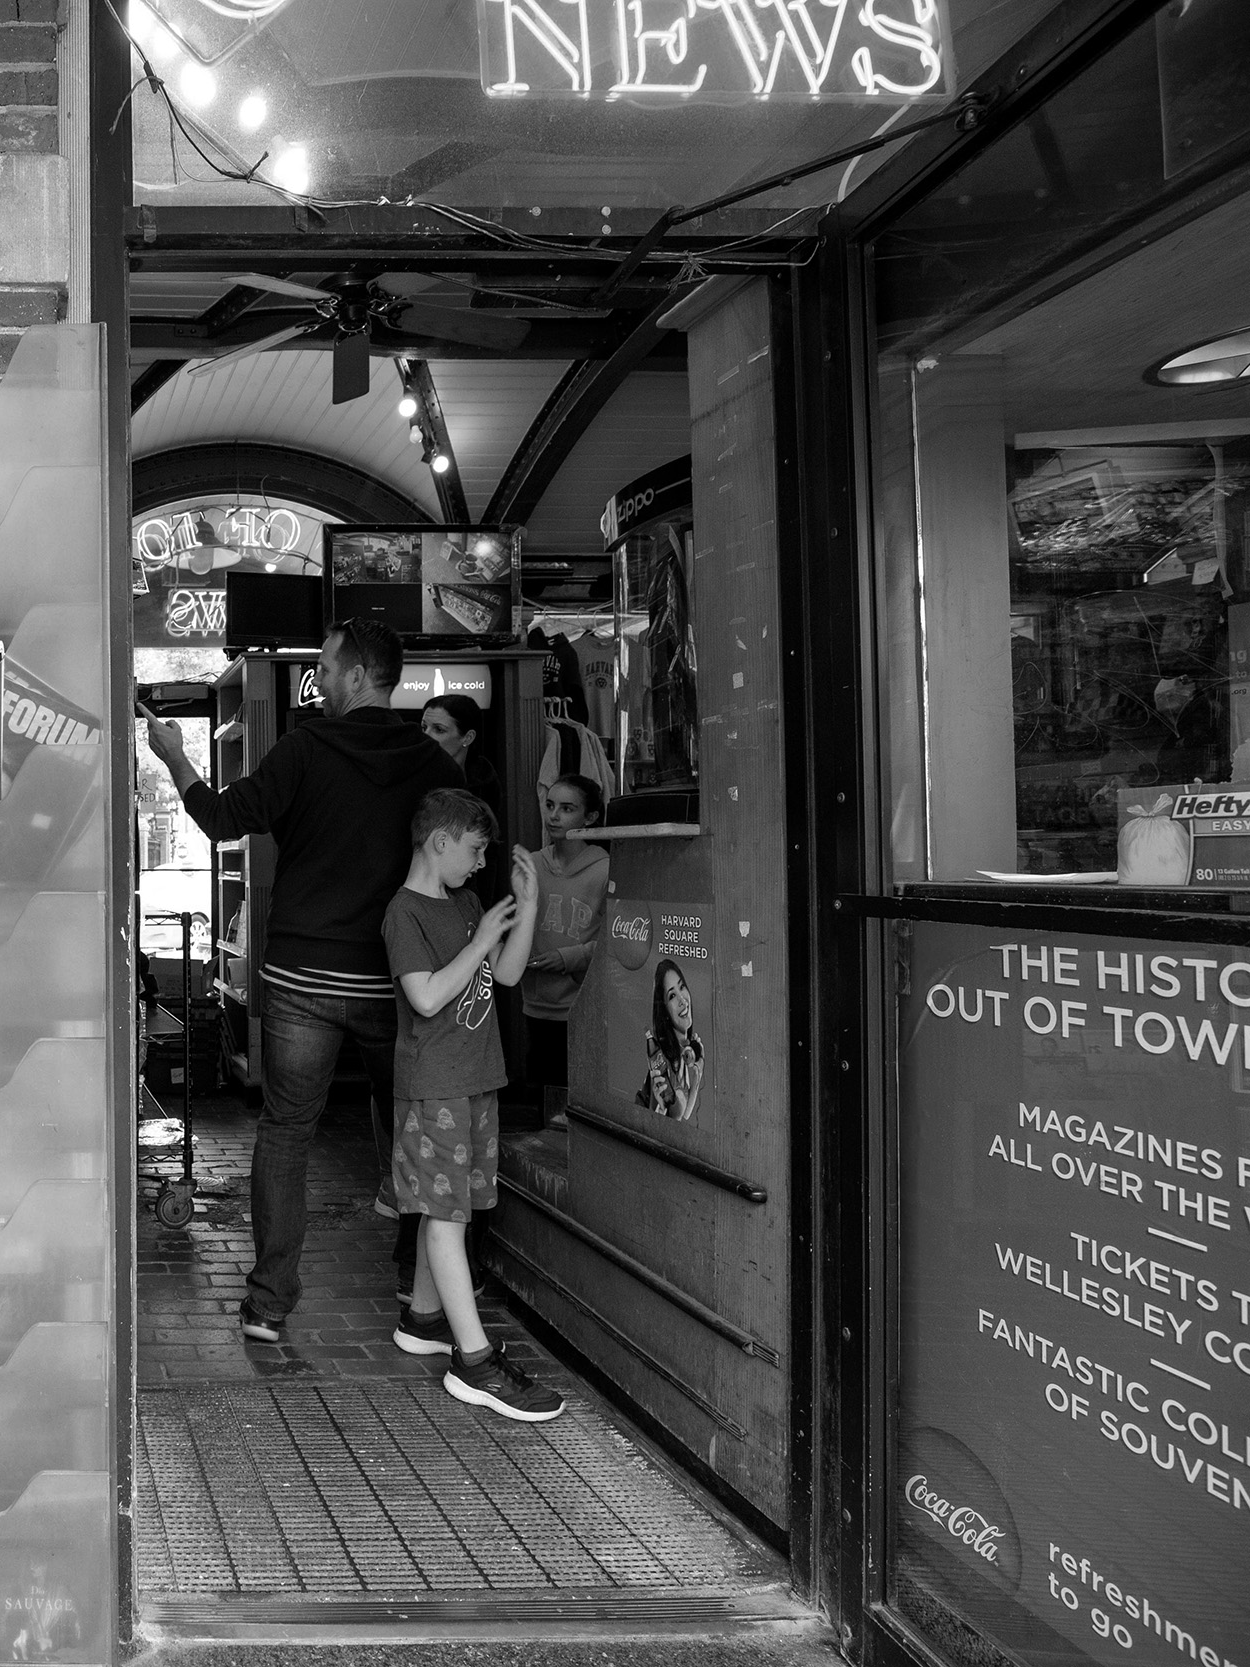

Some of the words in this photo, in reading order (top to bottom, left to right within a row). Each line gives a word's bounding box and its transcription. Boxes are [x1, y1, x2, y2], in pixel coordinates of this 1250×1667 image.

[491, 0, 940, 97] NEWS
[617, 488, 654, 523] zippo
[403, 681, 430, 691] enjoy
[464, 681, 485, 689] cold
[3, 689, 100, 757] FORUM
[1177, 795, 1250, 818] Hefty
[1196, 868, 1214, 880] 80
[612, 915, 651, 942] Coca-Cola
[658, 942, 708, 959] REFRESHED
[661, 915, 702, 928] HARVARD
[664, 929, 699, 943] SQUARE
[998, 944, 1080, 986] THE
[1097, 950, 1250, 1007] HISTO
[926, 984, 1009, 1026] OUT
[1023, 996, 1087, 1038] OF
[1103, 1006, 1250, 1070] TOW
[1019, 1102, 1223, 1180] MAGAZINES
[988, 1134, 1042, 1172] ALL
[1051, 1152, 1143, 1203] OVER
[1154, 1179, 1230, 1231] THE
[995, 1242, 1191, 1345] WELLESLEY
[1070, 1231, 1219, 1311] TICKETS
[978, 1308, 1149, 1413] FANTASTIC
[1161, 1398, 1250, 1467] COL
[1044, 1383, 1089, 1420] OF
[905, 1474, 1005, 1565] Coca-Cola
[5, 1597, 73, 1611] SAUVAGE
[1049, 1542, 1238, 1667] refreshme
[1049, 1572, 1079, 1610] to
[1091, 1607, 1132, 1649] go
